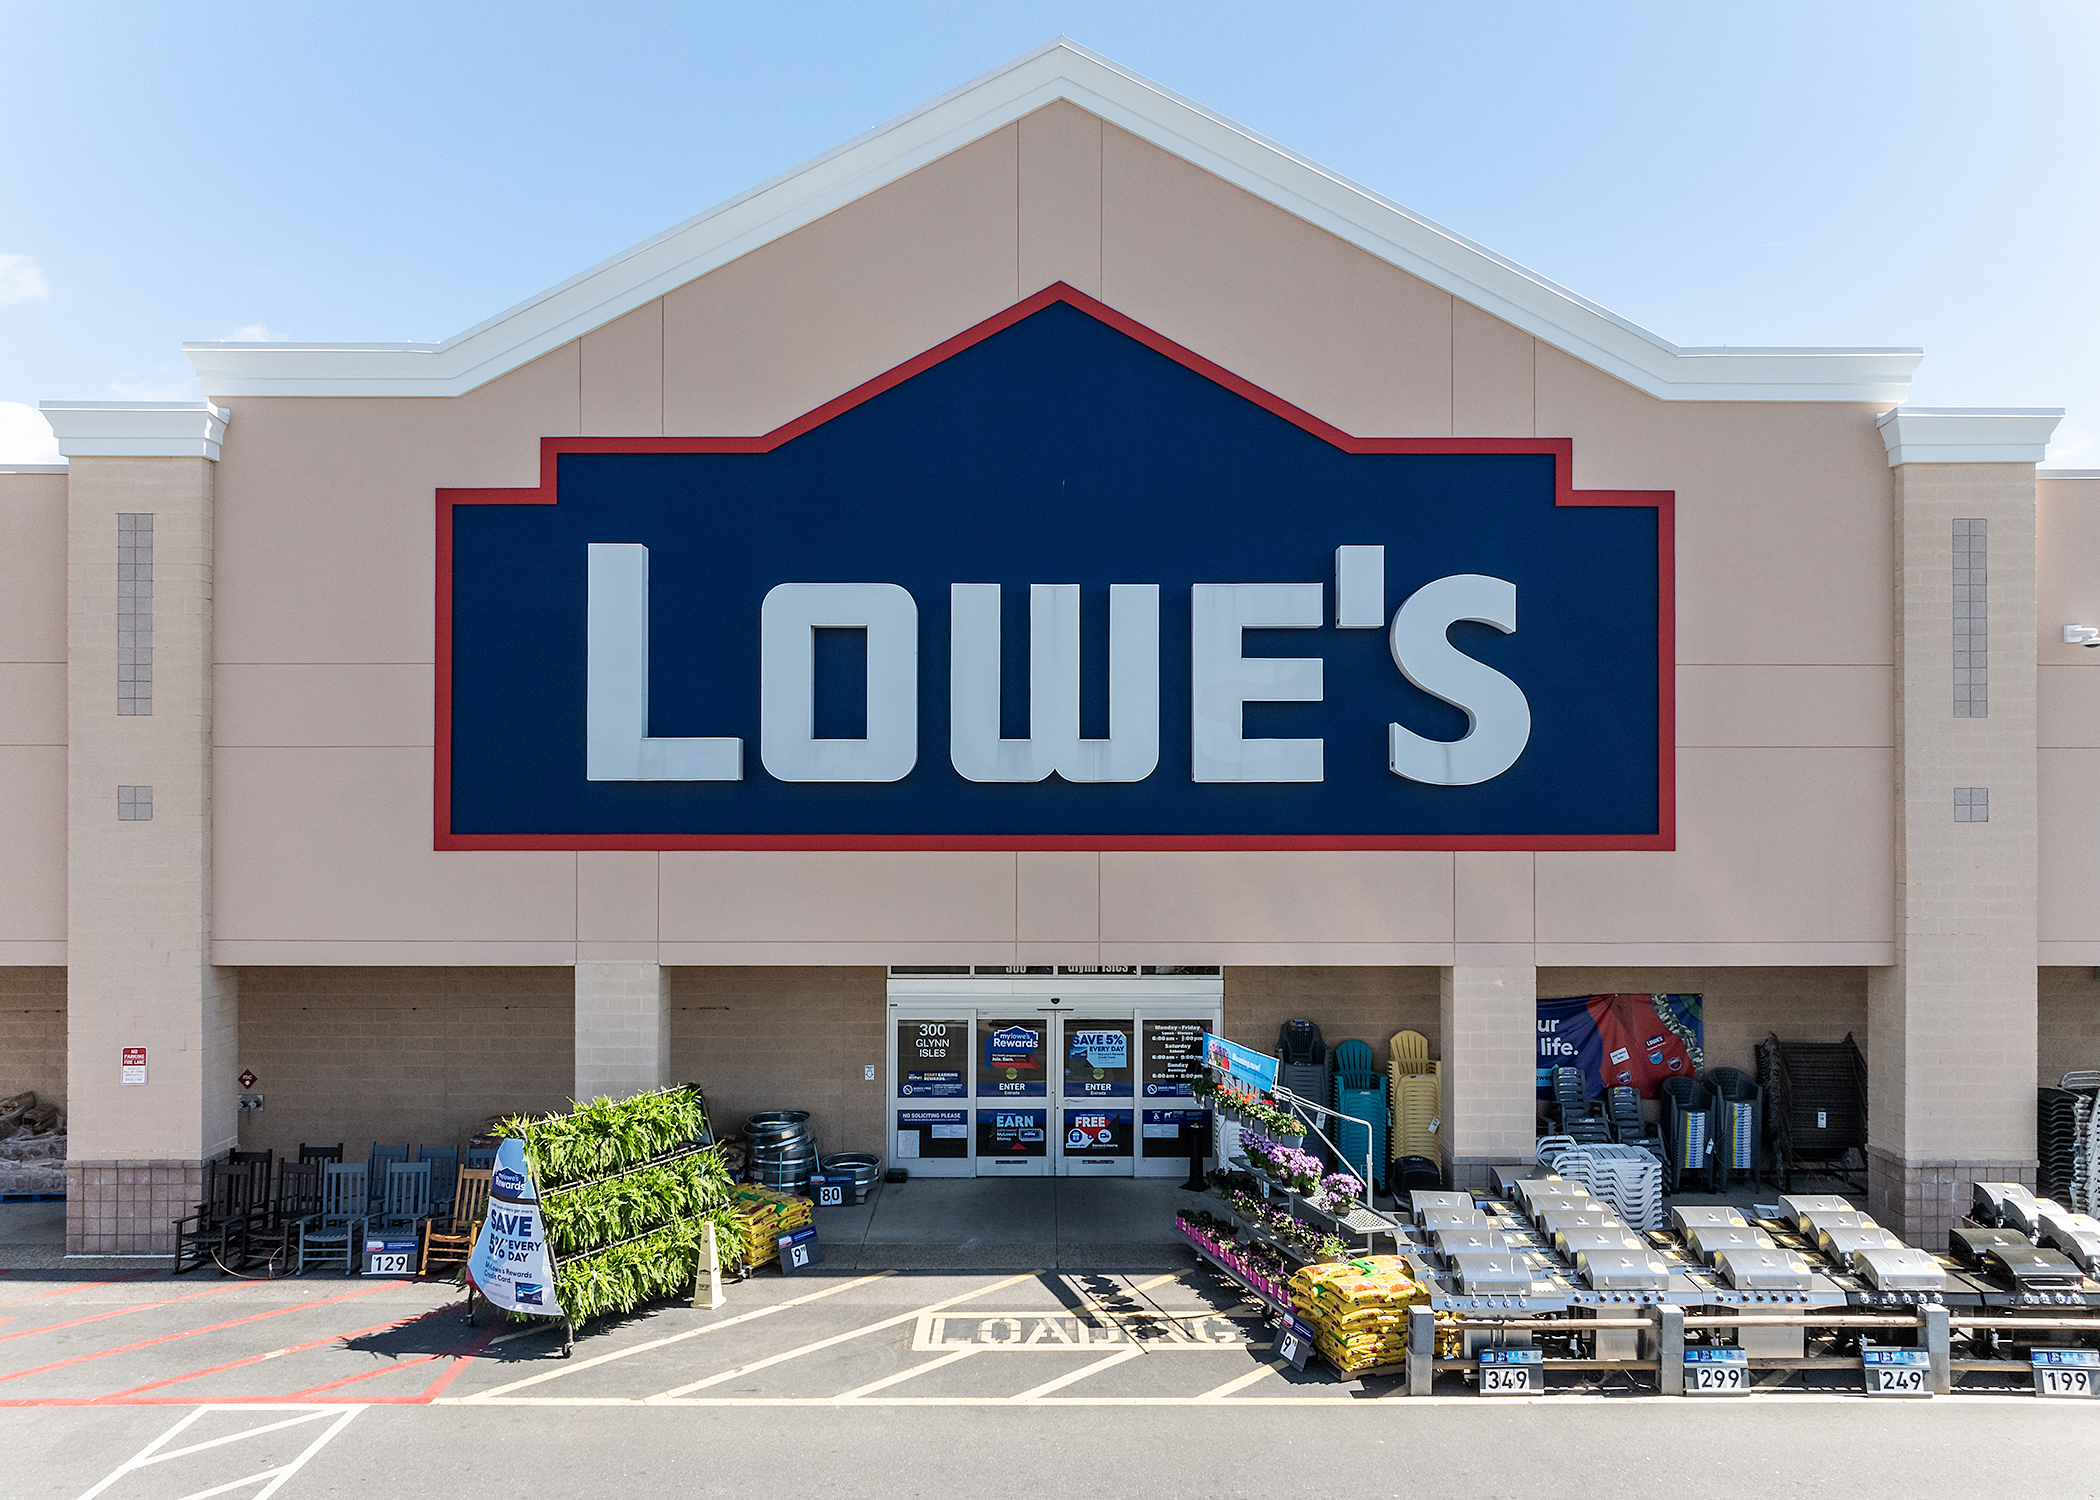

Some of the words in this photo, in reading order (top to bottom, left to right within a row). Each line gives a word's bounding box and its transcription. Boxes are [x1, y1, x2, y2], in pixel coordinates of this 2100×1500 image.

[587, 542, 1531, 784] LOWE'S
[919, 1024, 946, 1036] 300
[915, 1039, 950, 1047] GLYNN
[994, 1038, 1038, 1048] Rewards
[1073, 1034, 1103, 1045] SAVE
[1106, 1034, 1123, 1045] 5%
[1541, 1037, 1579, 1056] life.
[920, 1049, 946, 1057] ISLES
[996, 1116, 1033, 1127] EARN
[1075, 1116, 1105, 1127] FREE
[491, 1209, 533, 1237] SAVE
[508, 1240, 542, 1251] EVERY
[508, 1252, 529, 1262] DAY
[498, 1274, 512, 1283] Card.
[506, 1268, 532, 1279] Rewards
[932, 1317, 1239, 1344] LOADING
